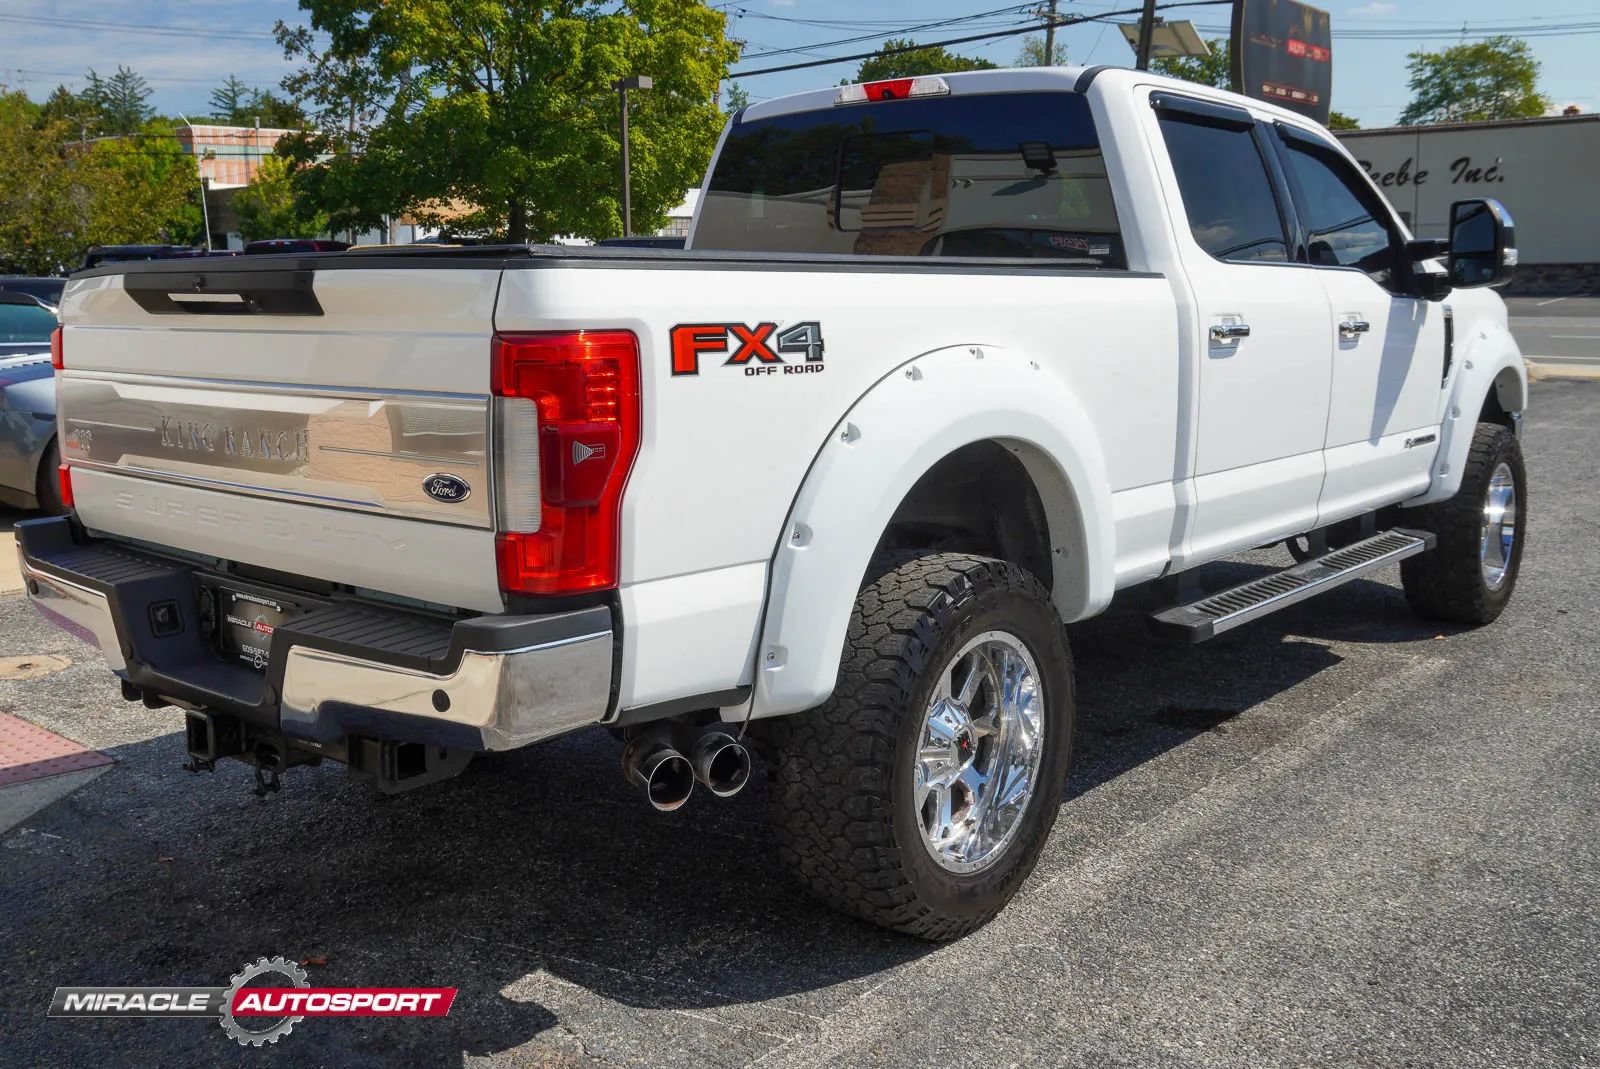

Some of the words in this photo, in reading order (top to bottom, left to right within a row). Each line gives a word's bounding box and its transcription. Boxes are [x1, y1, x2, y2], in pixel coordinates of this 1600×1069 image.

[1450, 156, 1505, 184] Inc.
[669, 320, 825, 377] FX4
[744, 366, 777, 377] OFF
[783, 364, 825, 375] ROAD
[161, 415, 215, 452] KING
[224, 426, 310, 463] RANCH
[430, 478, 459, 497] Ford
[114, 491, 250, 531] SUPER
[227, 615, 252, 628] MIRACLE
